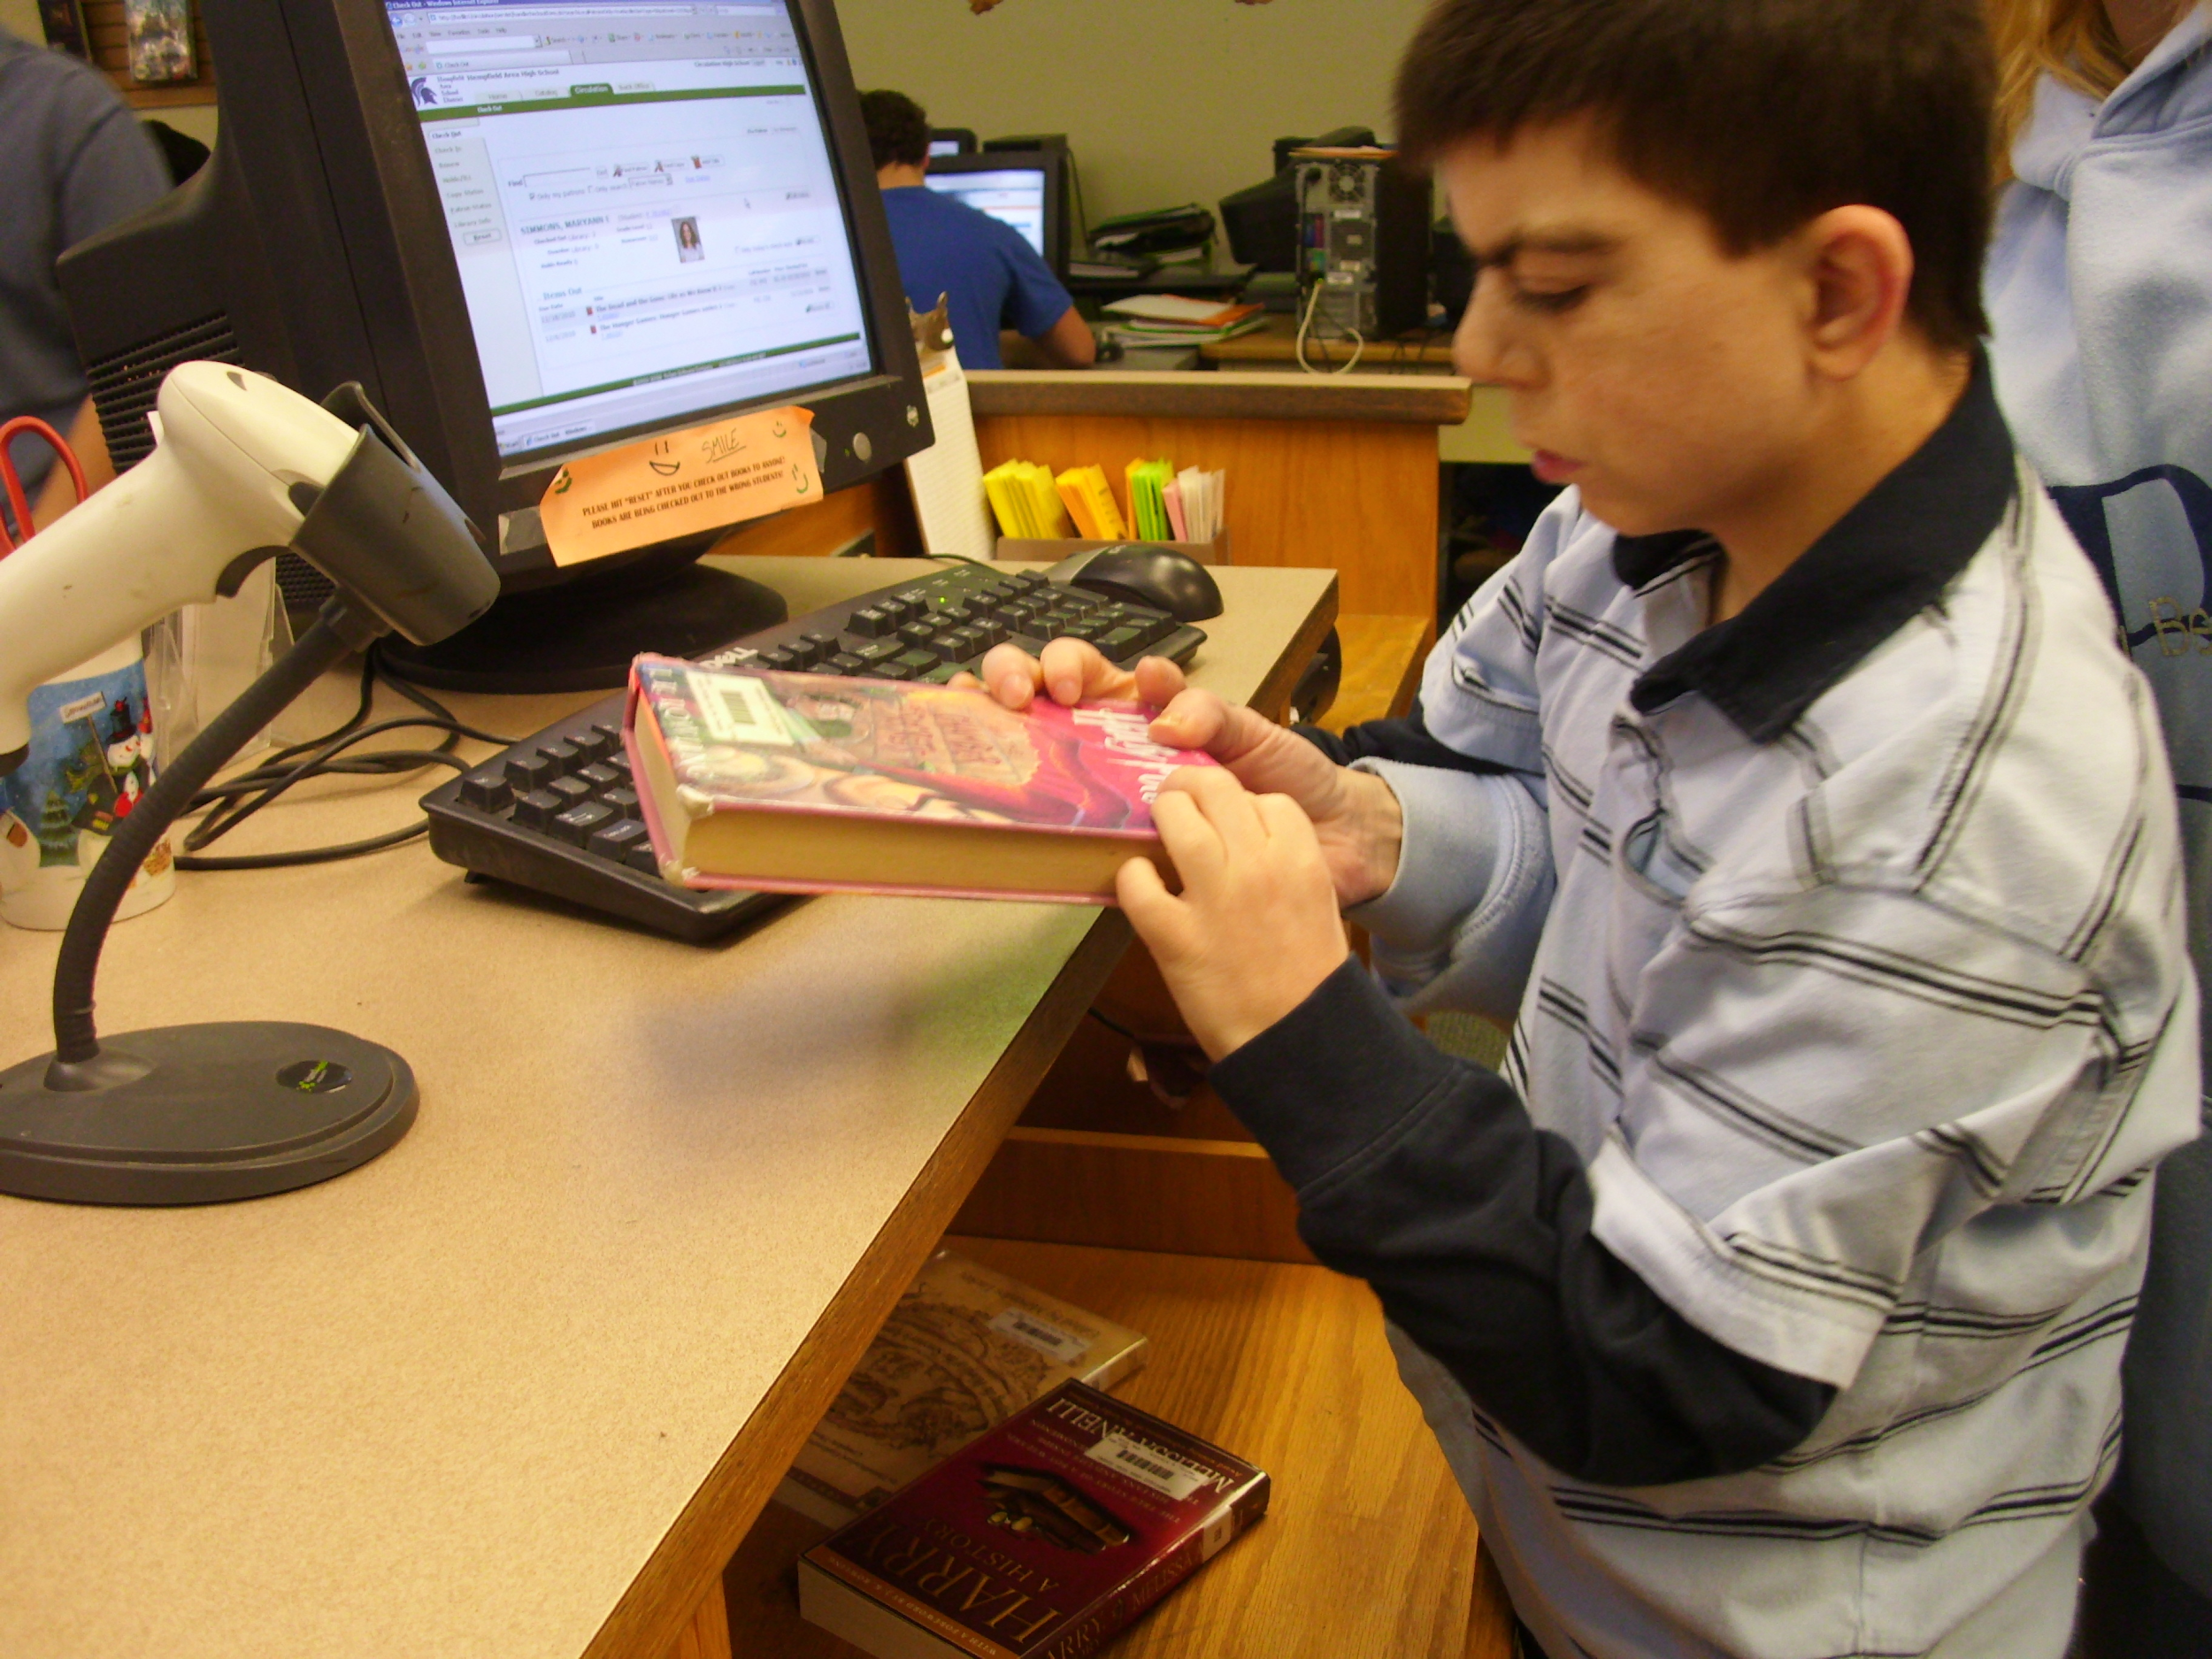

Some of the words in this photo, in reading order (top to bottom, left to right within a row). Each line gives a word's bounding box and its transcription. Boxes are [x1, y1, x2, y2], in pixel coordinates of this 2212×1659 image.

[542, 289, 566, 301] Items
[568, 287, 582, 296] Out
[701, 427, 746, 465] SMILE
[582, 503, 609, 516] PLEASE
[611, 498, 623, 509] HIT
[625, 491, 653, 504] "RESET"
[655, 485, 677, 497] AFTER
[678, 482, 691, 492] YOU
[694, 475, 715, 488] CHECK
[717, 471, 729, 482] OUT
[731, 466, 751, 479] BOOKS
[753, 463, 761, 472] TO
[591, 517, 618, 529] BOOKS
[619, 511, 632, 521] ARE
[634, 505, 656, 518] BEING
[657, 496, 689, 511] CHECKED
[691, 491, 704, 503] OUT
[705, 490, 714, 500] TO
[715, 486, 727, 495] THE
[728, 480, 752, 492] WRONG
[752, 471, 784, 486] STUDENTS!
[919, 1517, 1035, 1582] HISTORY
[1038, 1576, 1061, 1592] A
